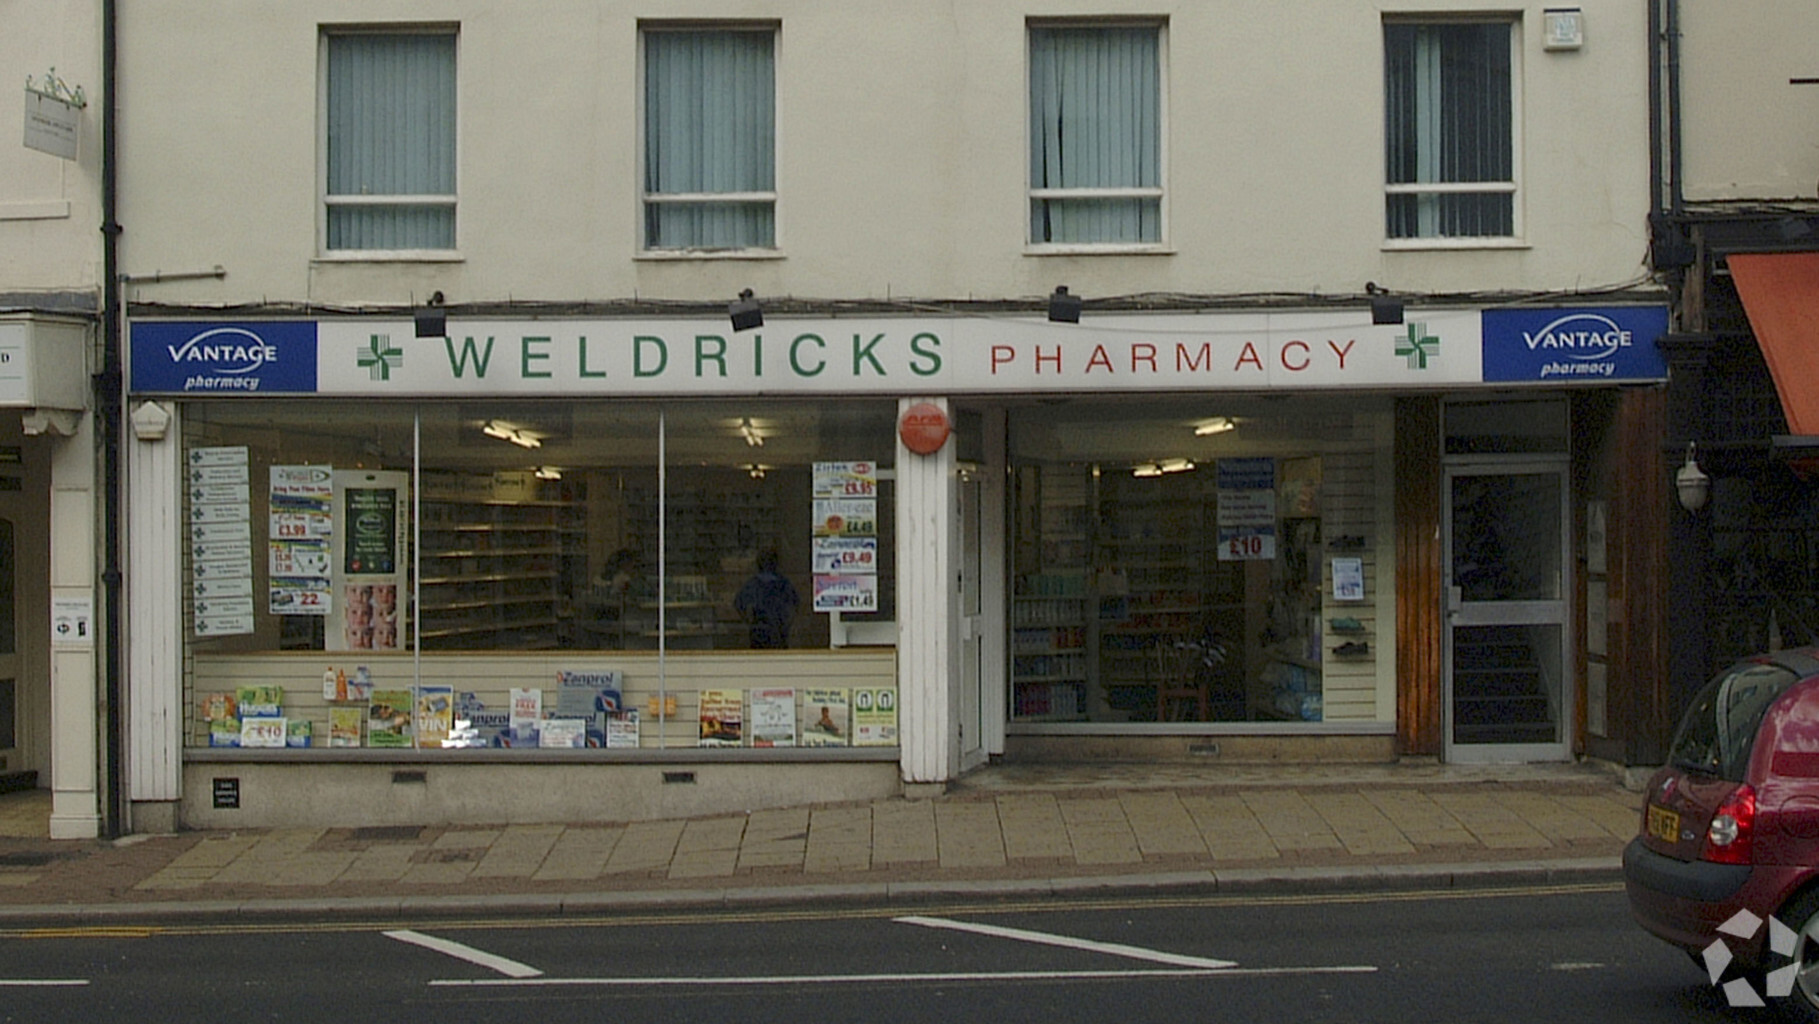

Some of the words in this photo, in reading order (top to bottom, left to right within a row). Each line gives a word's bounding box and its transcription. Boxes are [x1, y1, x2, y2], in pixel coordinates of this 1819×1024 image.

[1522, 324, 1632, 352] VANTAGE
[168, 336, 278, 364] VANTAGE
[445, 333, 943, 379] WELDRICKS
[991, 340, 1355, 375] PHARMACY
[1540, 362, 1616, 378] pharmacy
[184, 375, 260, 391] pharmacy
[1229, 536, 1262, 555] £10
[563, 671, 614, 686] Zanprol
